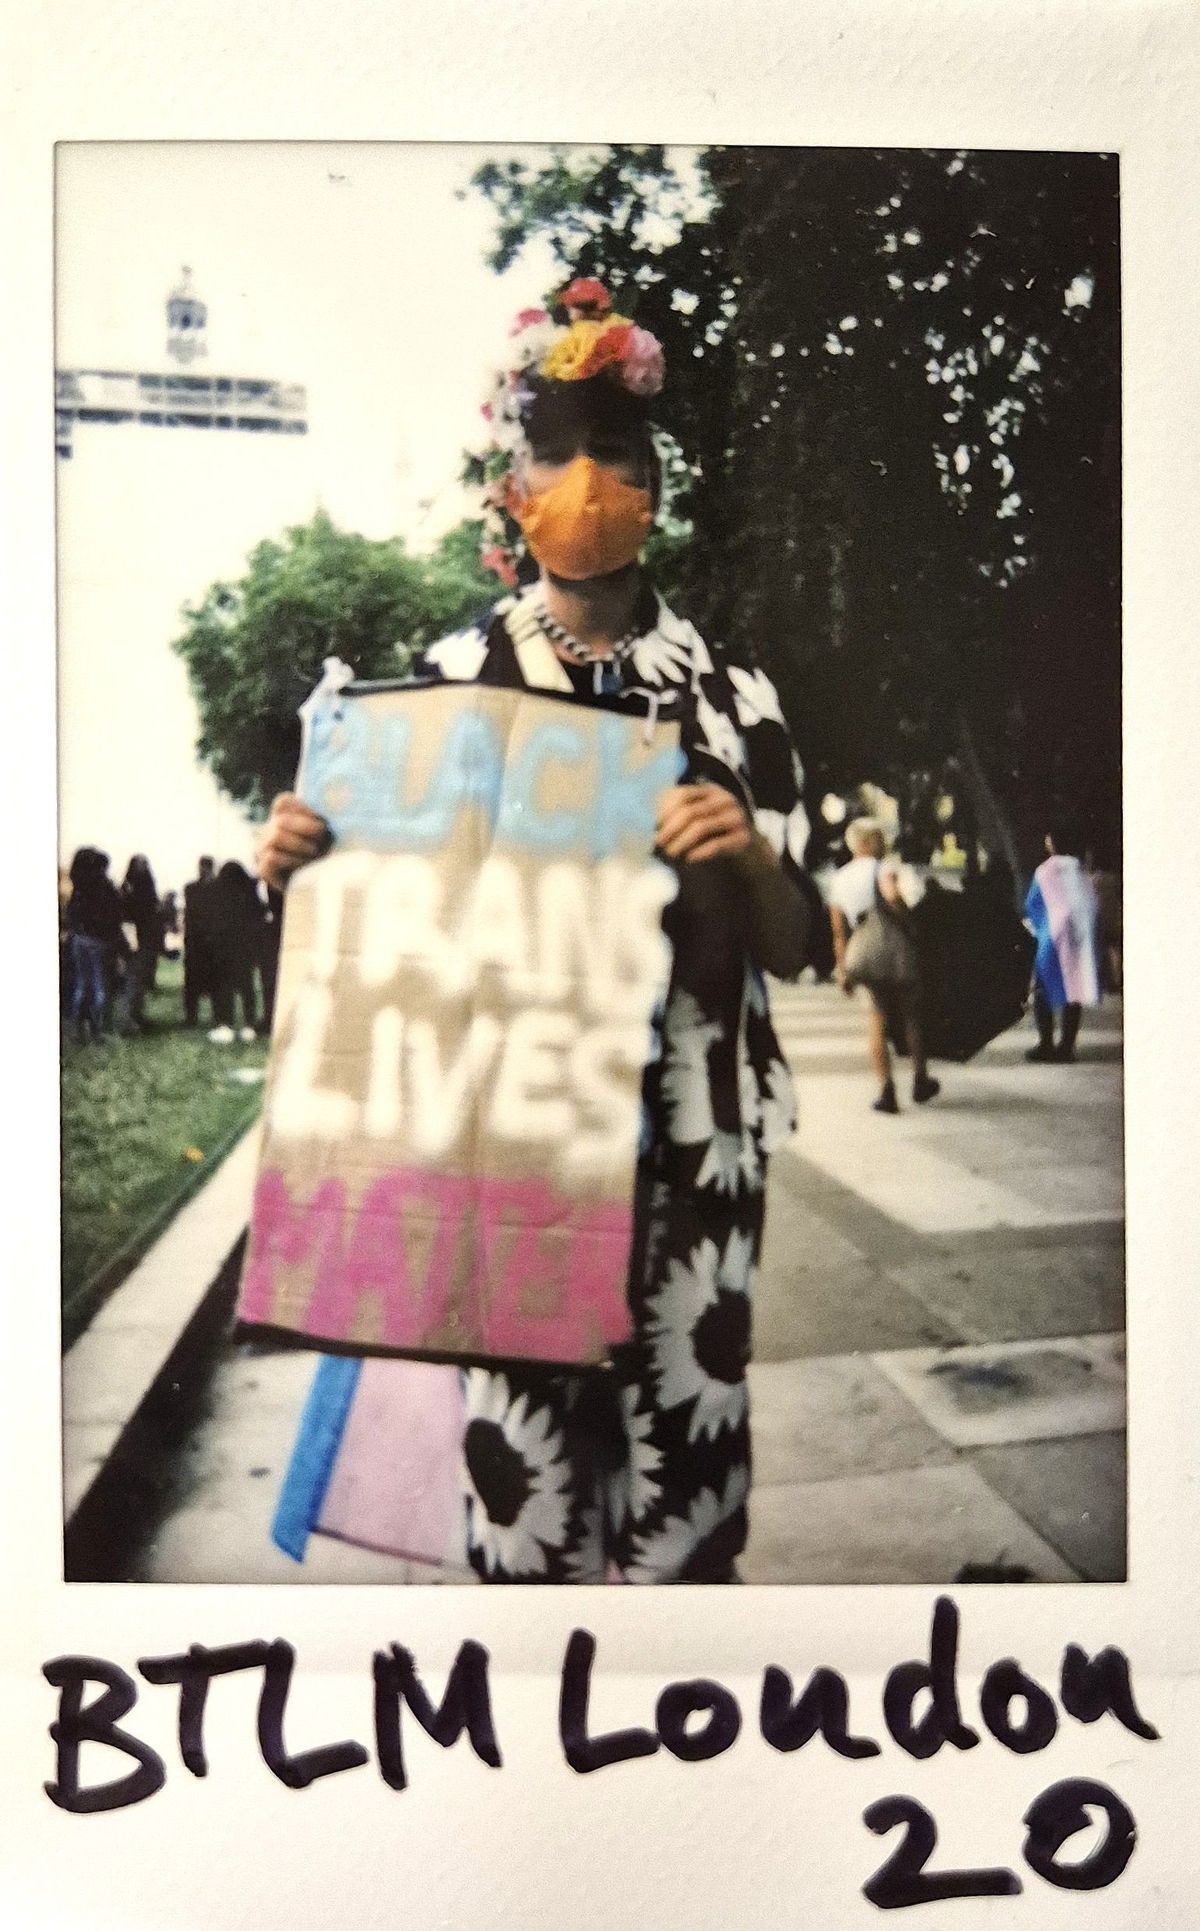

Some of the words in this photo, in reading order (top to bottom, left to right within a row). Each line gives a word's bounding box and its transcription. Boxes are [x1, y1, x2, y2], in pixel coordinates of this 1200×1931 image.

[306, 700, 690, 860] BLACK
[289, 850, 679, 1014] TRANS
[271, 983, 660, 1172] LIVES
[238, 1166, 635, 1363] MATTER
[42, 1638, 502, 1813] BTLM
[559, 1597, 1162, 1773] London
[863, 1778, 1138, 1910] 20
